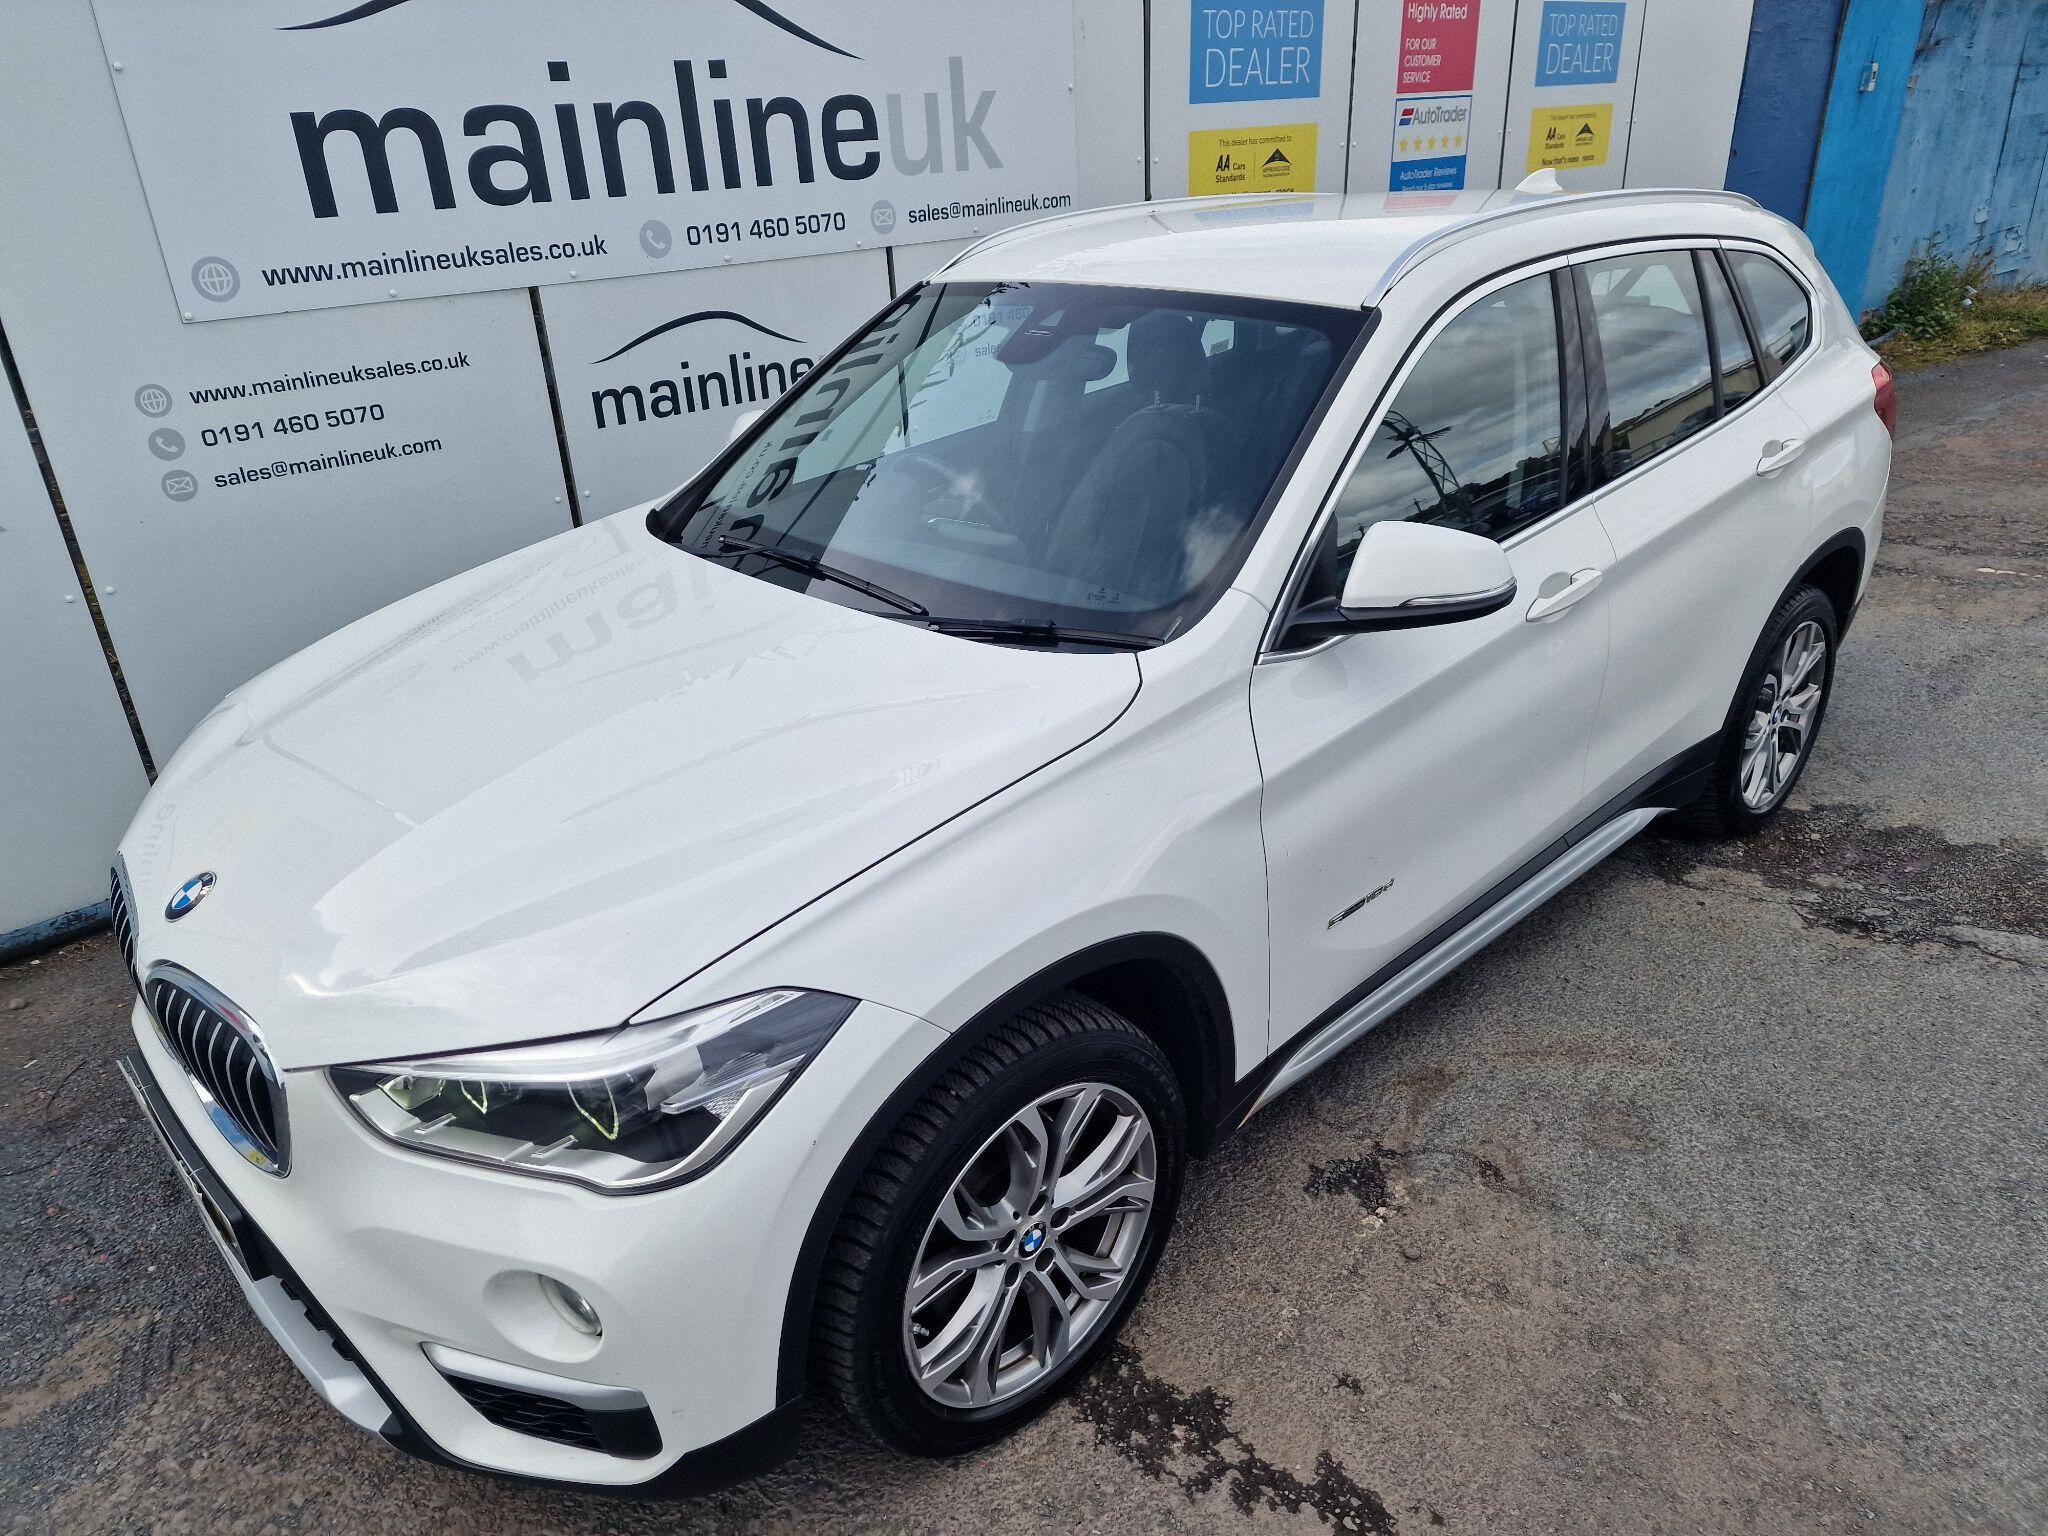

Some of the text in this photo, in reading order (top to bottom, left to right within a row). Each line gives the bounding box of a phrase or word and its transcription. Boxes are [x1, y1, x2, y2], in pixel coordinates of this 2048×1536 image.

[1203, 9, 1314, 38] TOP RATED
[1408, 3, 1468, 22] Highly Rated
[1549, 13, 1618, 37] TOP RATED
[1405, 38, 1437, 50] FOR OUR
[1205, 47, 1310, 88] DEALER
[1404, 54, 1442, 67] CUSTOMER
[1546, 43, 1614, 74] DEALER
[1403, 71, 1431, 83] SERVICE
[1216, 154, 1230, 172] AA
[1232, 162, 1246, 171] Cars
[1215, 173, 1246, 184] Standards
[262, 193, 1072, 287] www.mainlineuksales.co.uk 0191 460 5070 sales@mainlineuk.com
[189, 351, 471, 404] www.mainlineuksales.co.uk
[201, 403, 385, 447] 0191 460 5070
[215, 438, 442, 488] sales@mainlineuk.com
